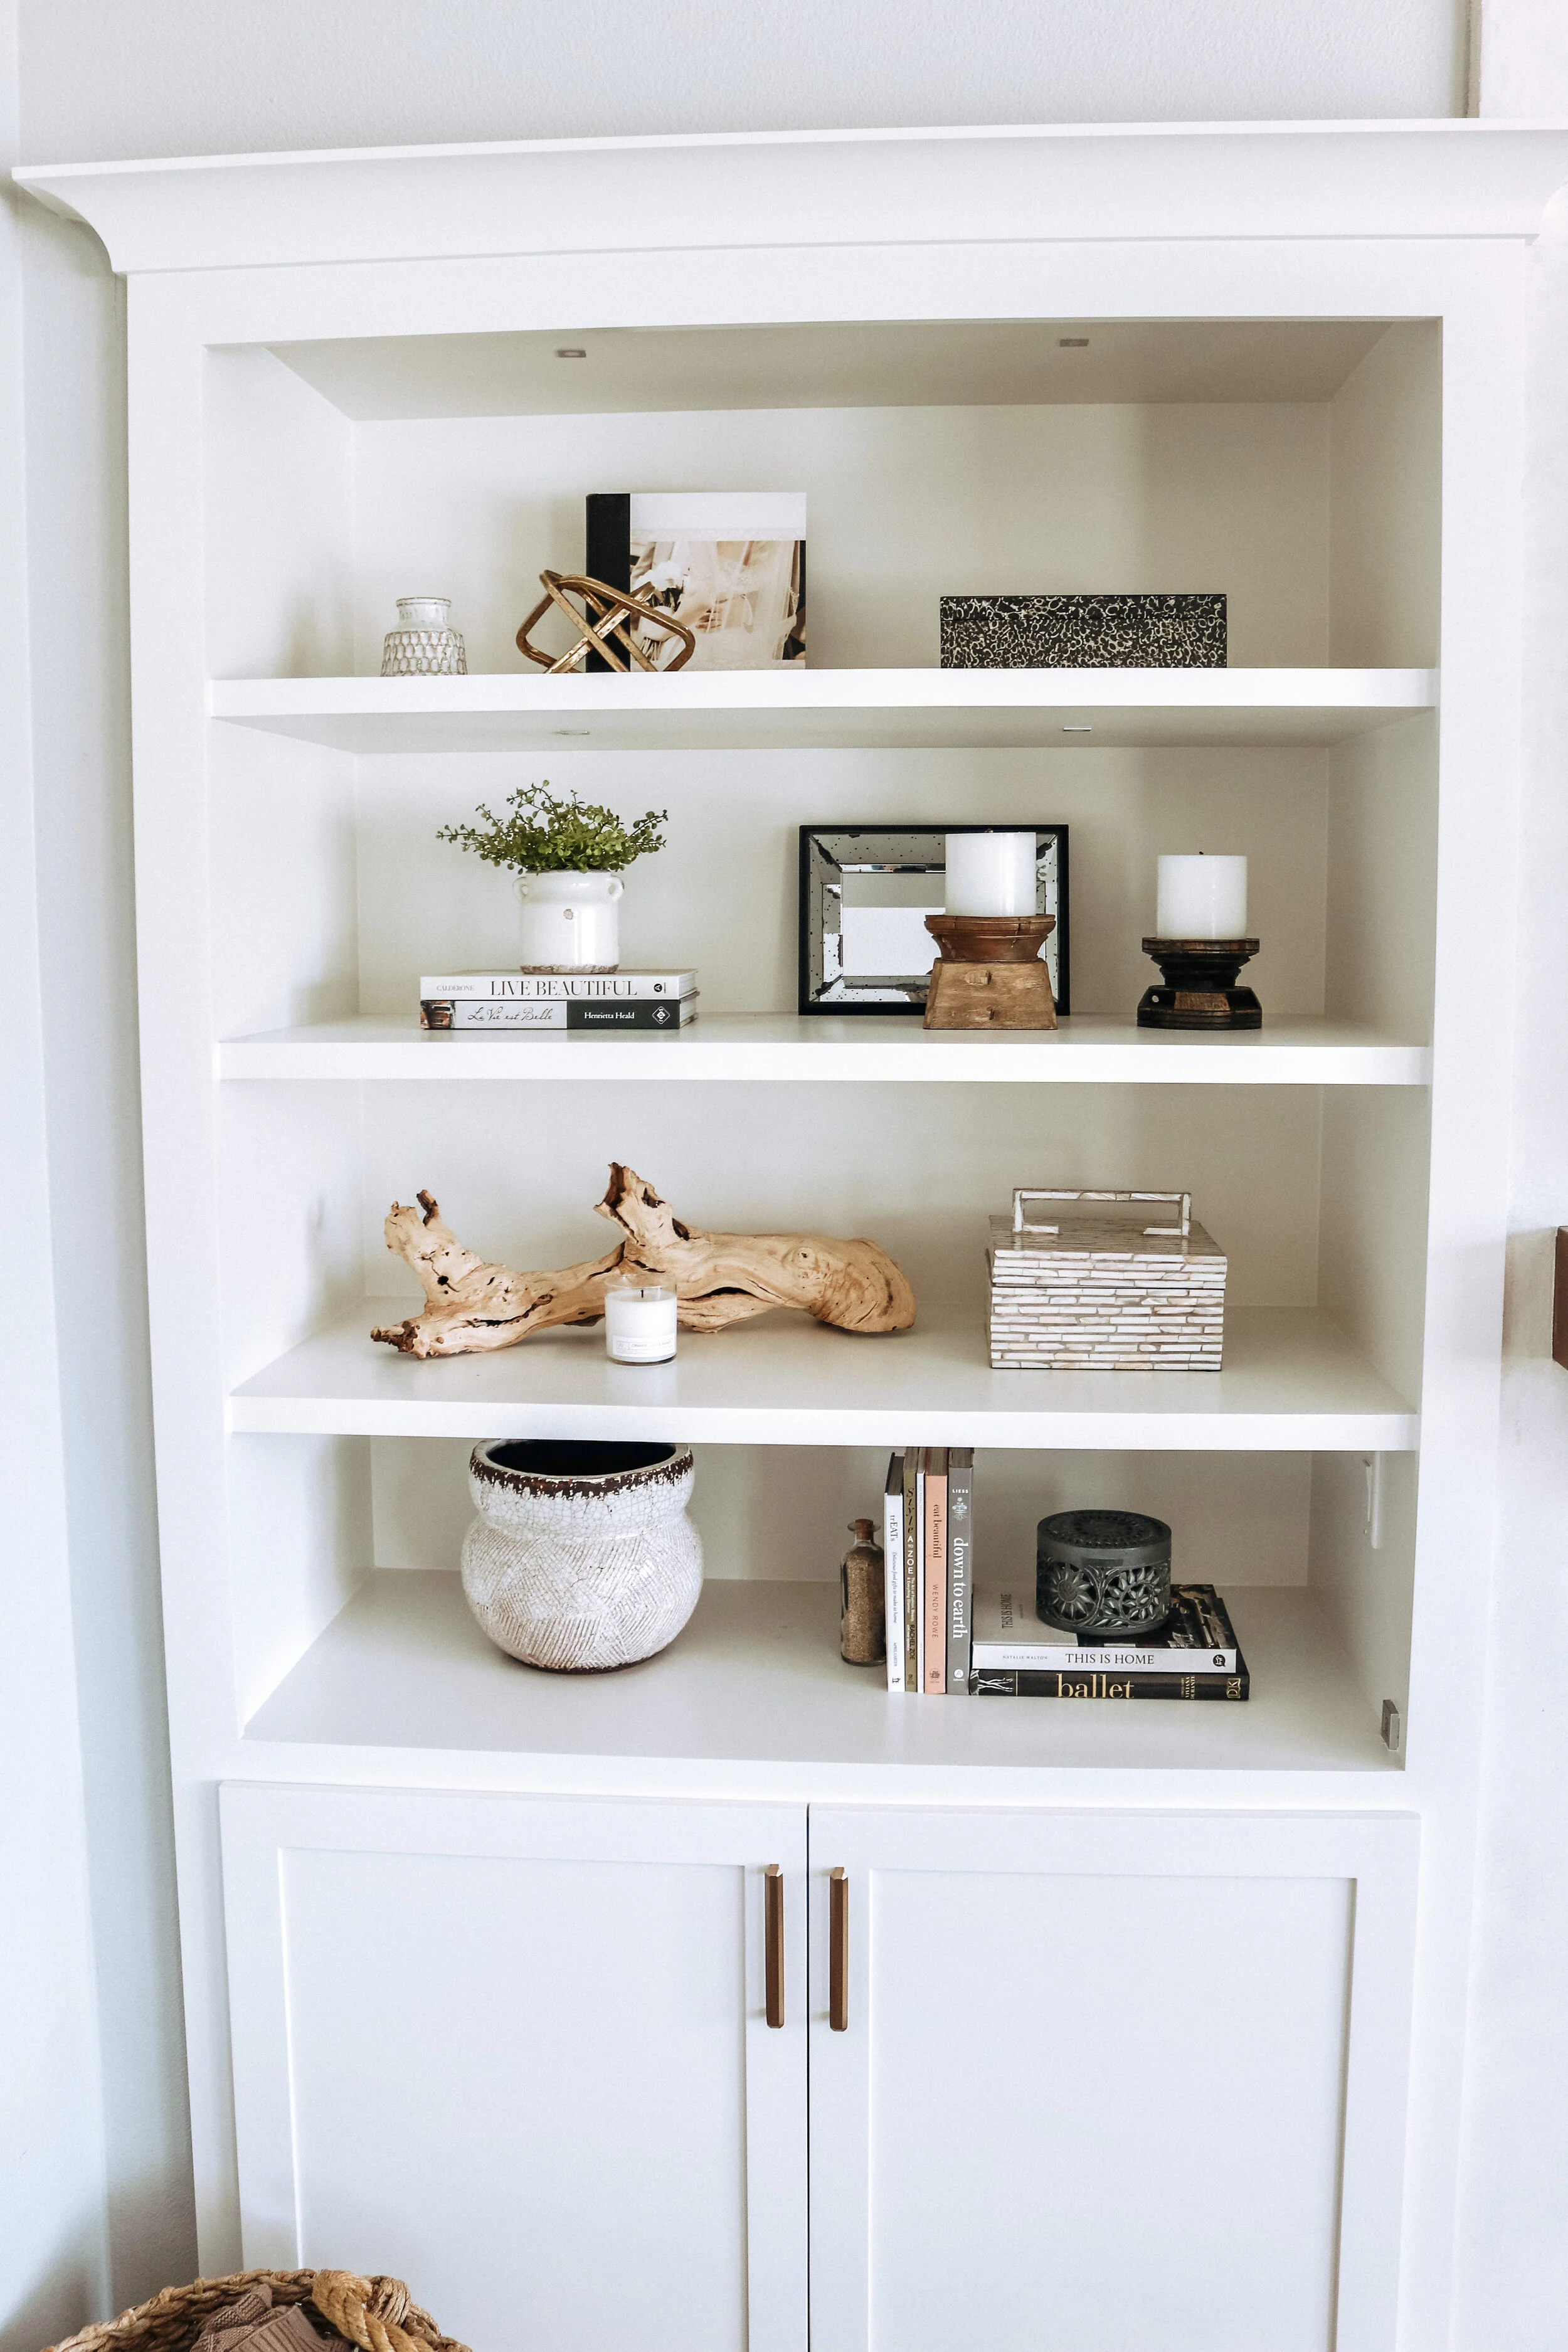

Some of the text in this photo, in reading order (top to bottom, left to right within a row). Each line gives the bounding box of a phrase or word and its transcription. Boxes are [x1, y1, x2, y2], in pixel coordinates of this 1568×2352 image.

[490, 980, 637, 996] LIVE BEAUTIFUL
[486, 1006, 503, 1021] Vie
[504, 1012, 520, 1021] est
[521, 1006, 553, 1021] Belle
[906, 1487, 914, 1534] Style
[933, 1520, 942, 1558] beautiful
[953, 1537, 968, 1639] down to earth
[1000, 1594, 1012, 1610] HOME
[1000, 1616, 1013, 1629] THIS
[1065, 1653, 1155, 1665] THIS IS HOME
[1056, 1673, 1135, 1698] ballet
[1227, 1679, 1239, 1697] DK
